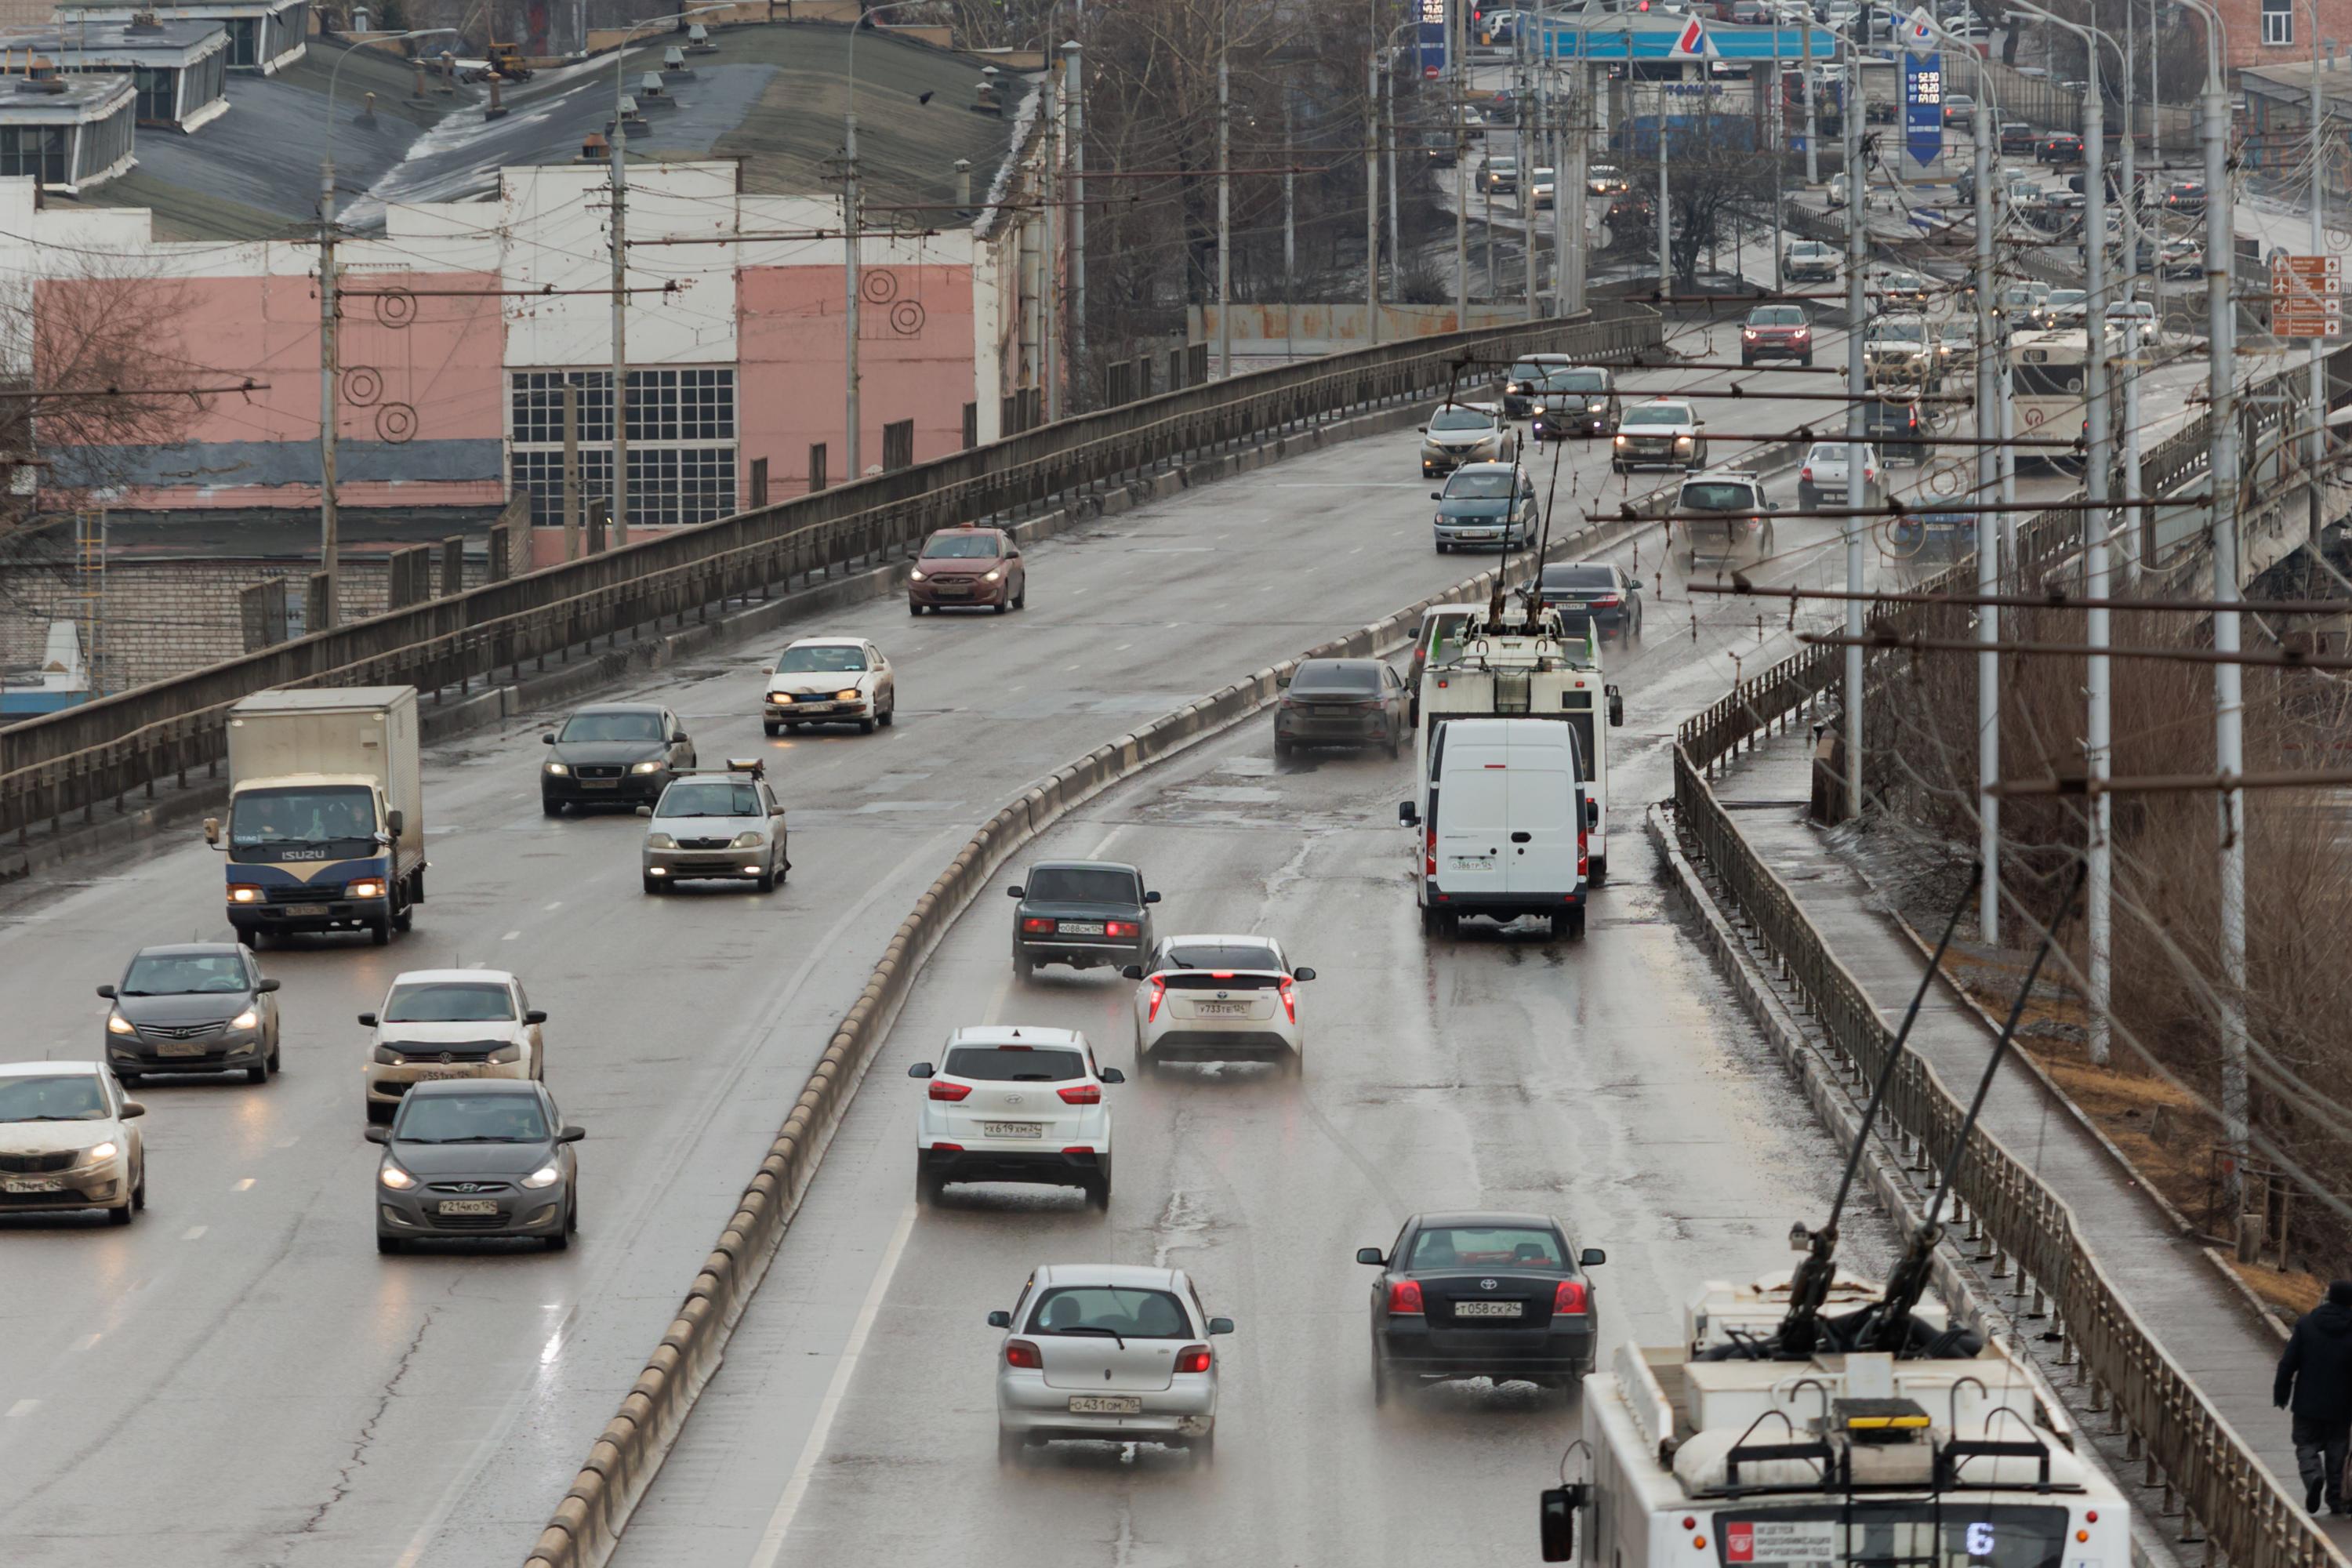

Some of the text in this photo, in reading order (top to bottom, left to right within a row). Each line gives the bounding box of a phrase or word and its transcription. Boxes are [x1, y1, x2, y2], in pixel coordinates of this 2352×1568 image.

[281, 850, 325, 860] ISUZU
[1460, 1303, 1504, 1314] Т058СК
[1967, 1522, 1994, 1555] 6
